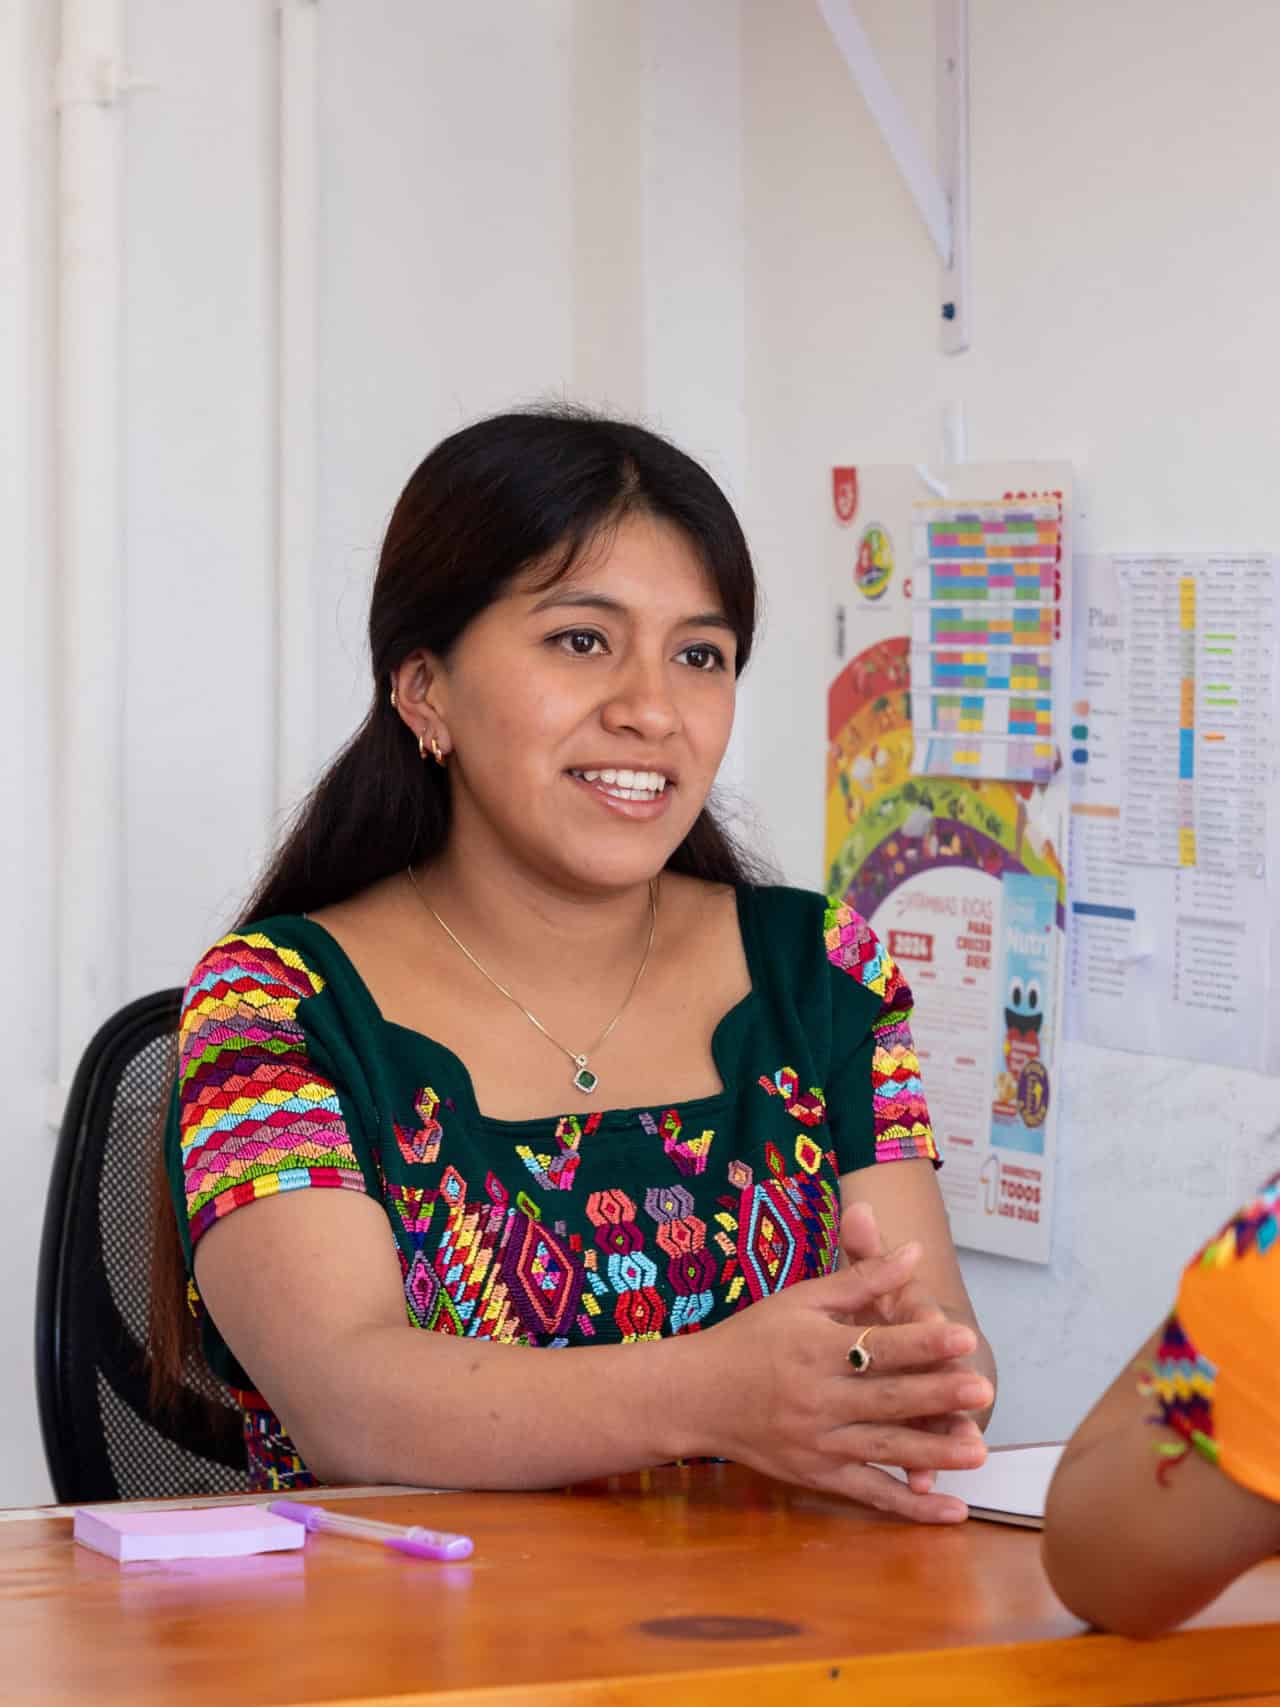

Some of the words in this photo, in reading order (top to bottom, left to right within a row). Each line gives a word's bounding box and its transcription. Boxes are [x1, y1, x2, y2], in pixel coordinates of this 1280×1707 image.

[968, 921, 992, 936] PARA
[1001, 1180, 1041, 1204] TODOS
[998, 1202, 1015, 1218] LOS
